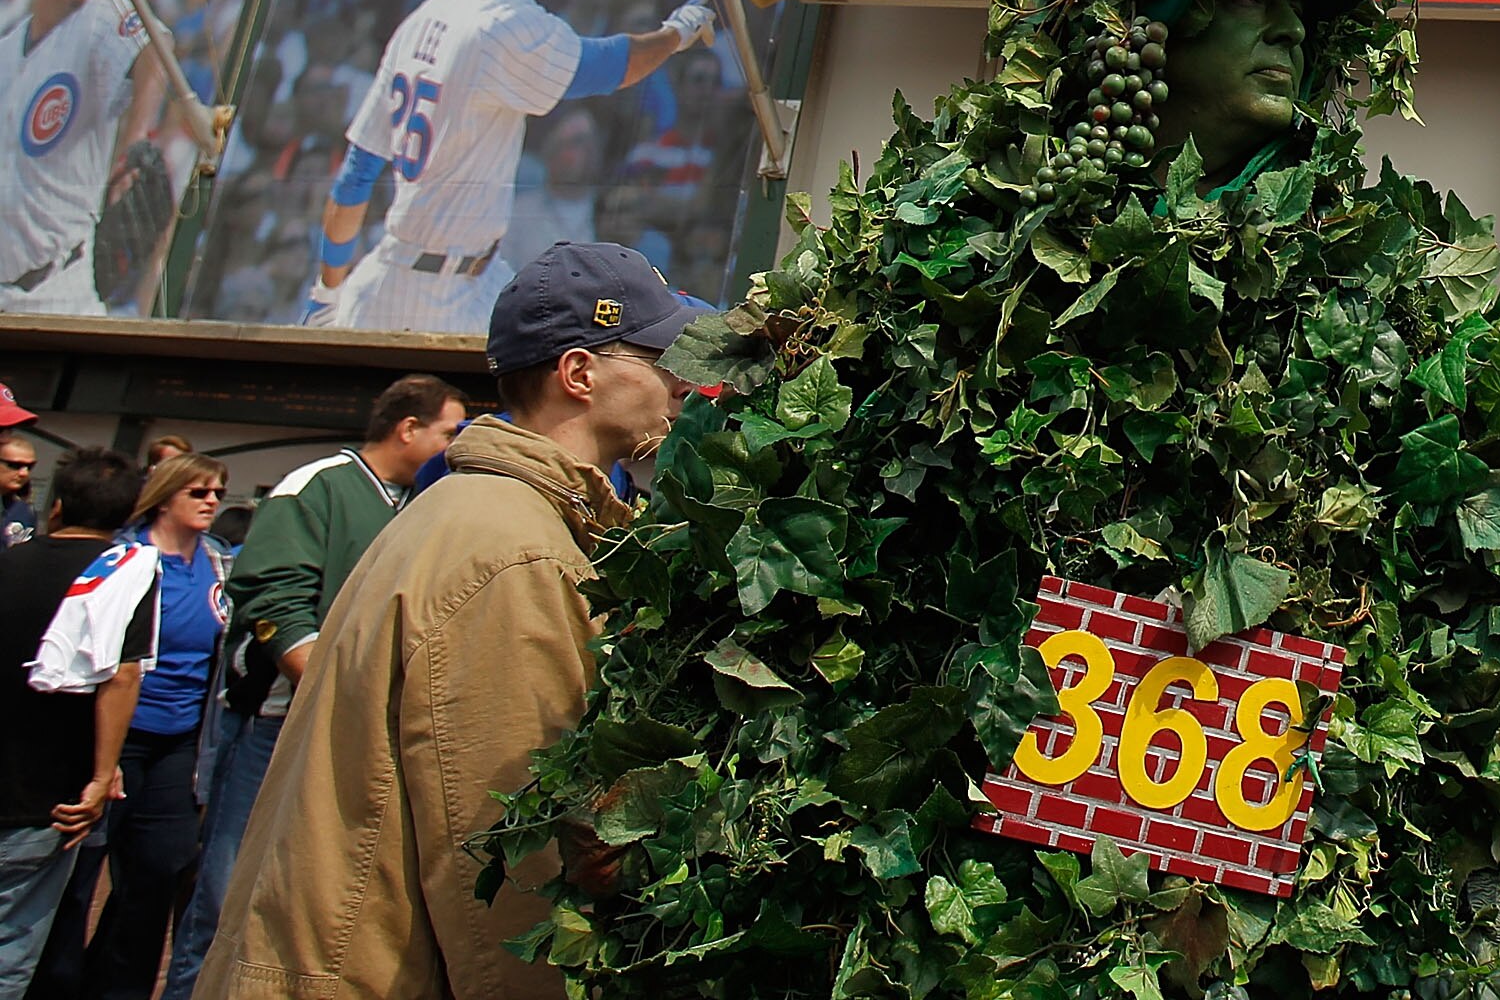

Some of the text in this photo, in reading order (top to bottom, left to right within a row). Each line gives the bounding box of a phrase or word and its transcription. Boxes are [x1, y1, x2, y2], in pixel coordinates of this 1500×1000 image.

[414, 18, 447, 66] LEE
[391, 72, 443, 183] 25
[1013, 630, 1308, 831] 368
